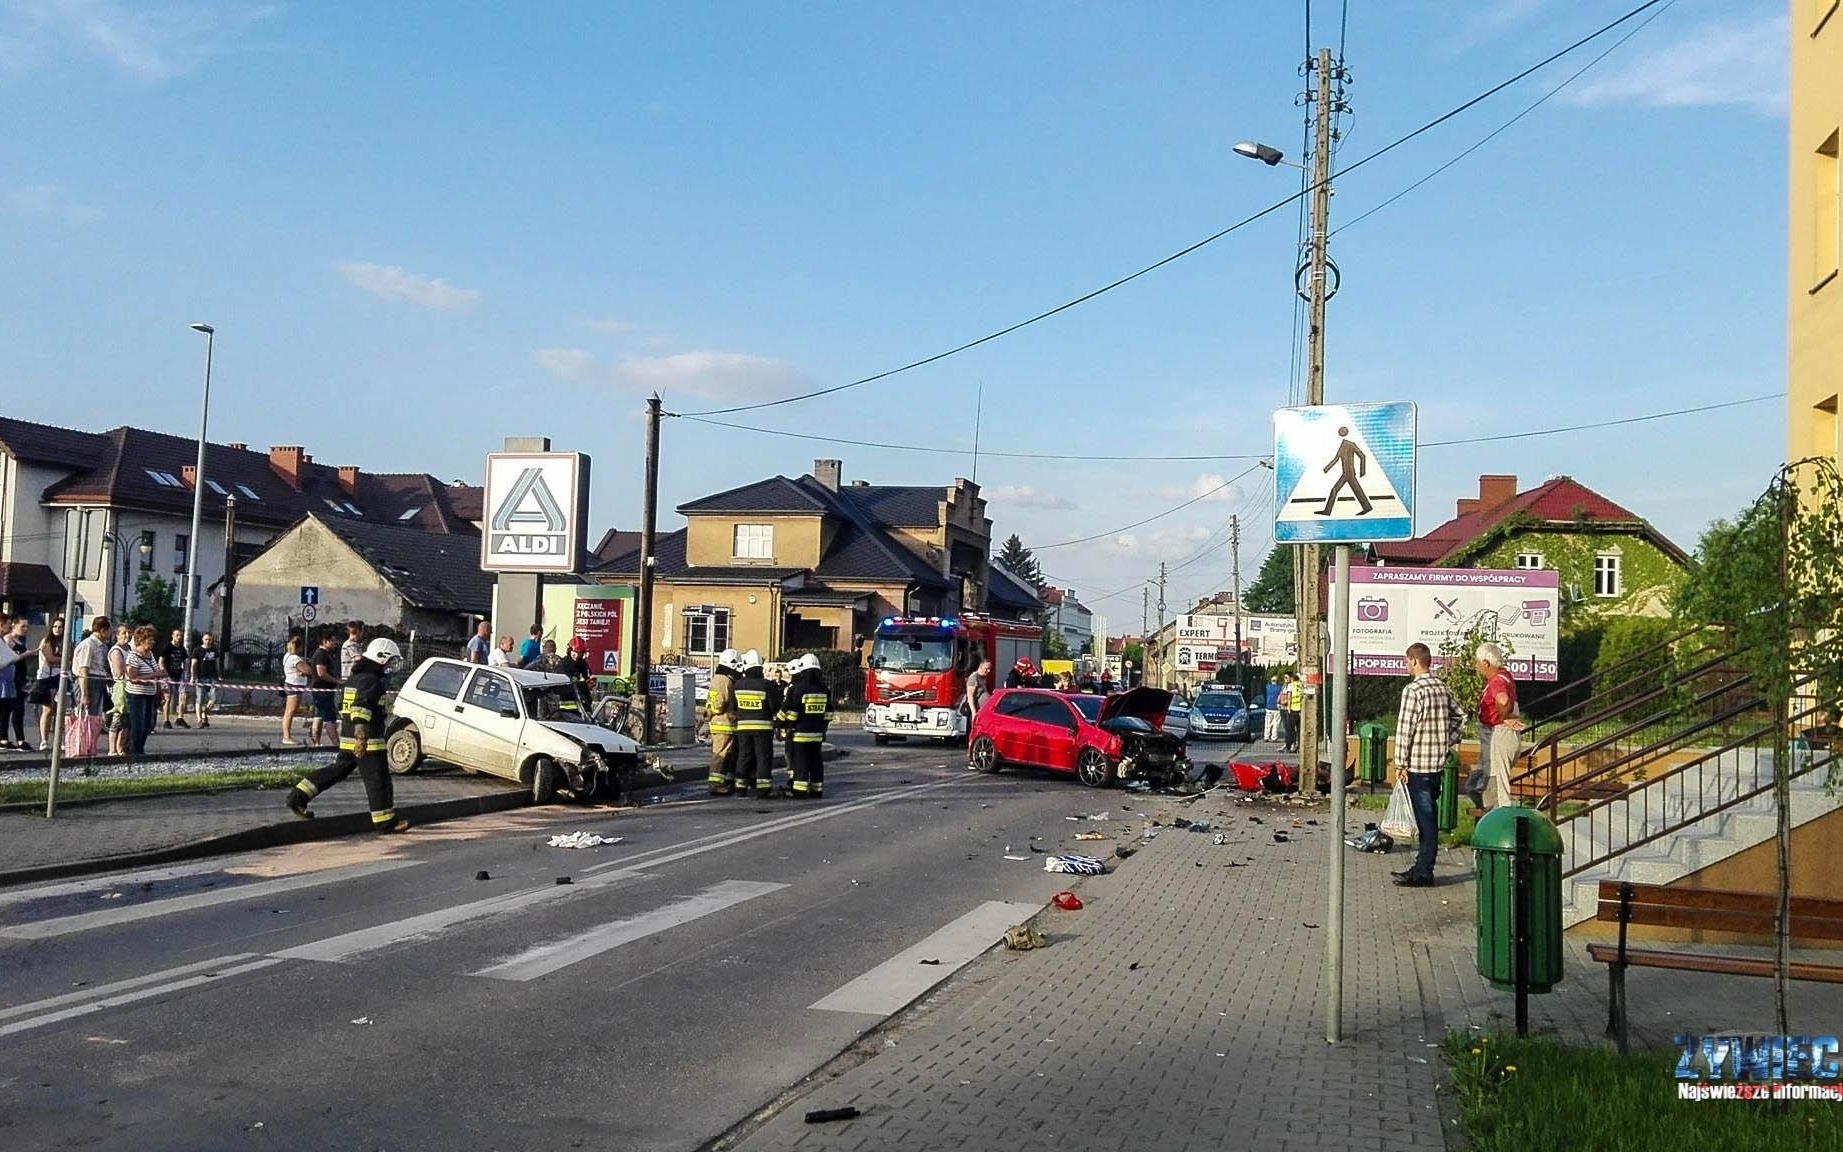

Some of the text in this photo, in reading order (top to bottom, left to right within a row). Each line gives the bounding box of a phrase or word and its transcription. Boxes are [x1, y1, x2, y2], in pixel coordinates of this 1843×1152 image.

[497, 535, 557, 553] ALDI
[1372, 572, 1428, 581] ZAPRASZAMY
[1429, 573, 1454, 582] FIRMY
[1470, 573, 1526, 583] WSPÓŁPRACY
[1179, 629, 1211, 638] EXPERT
[1501, 632, 1545, 640] DRUKOWANIE
